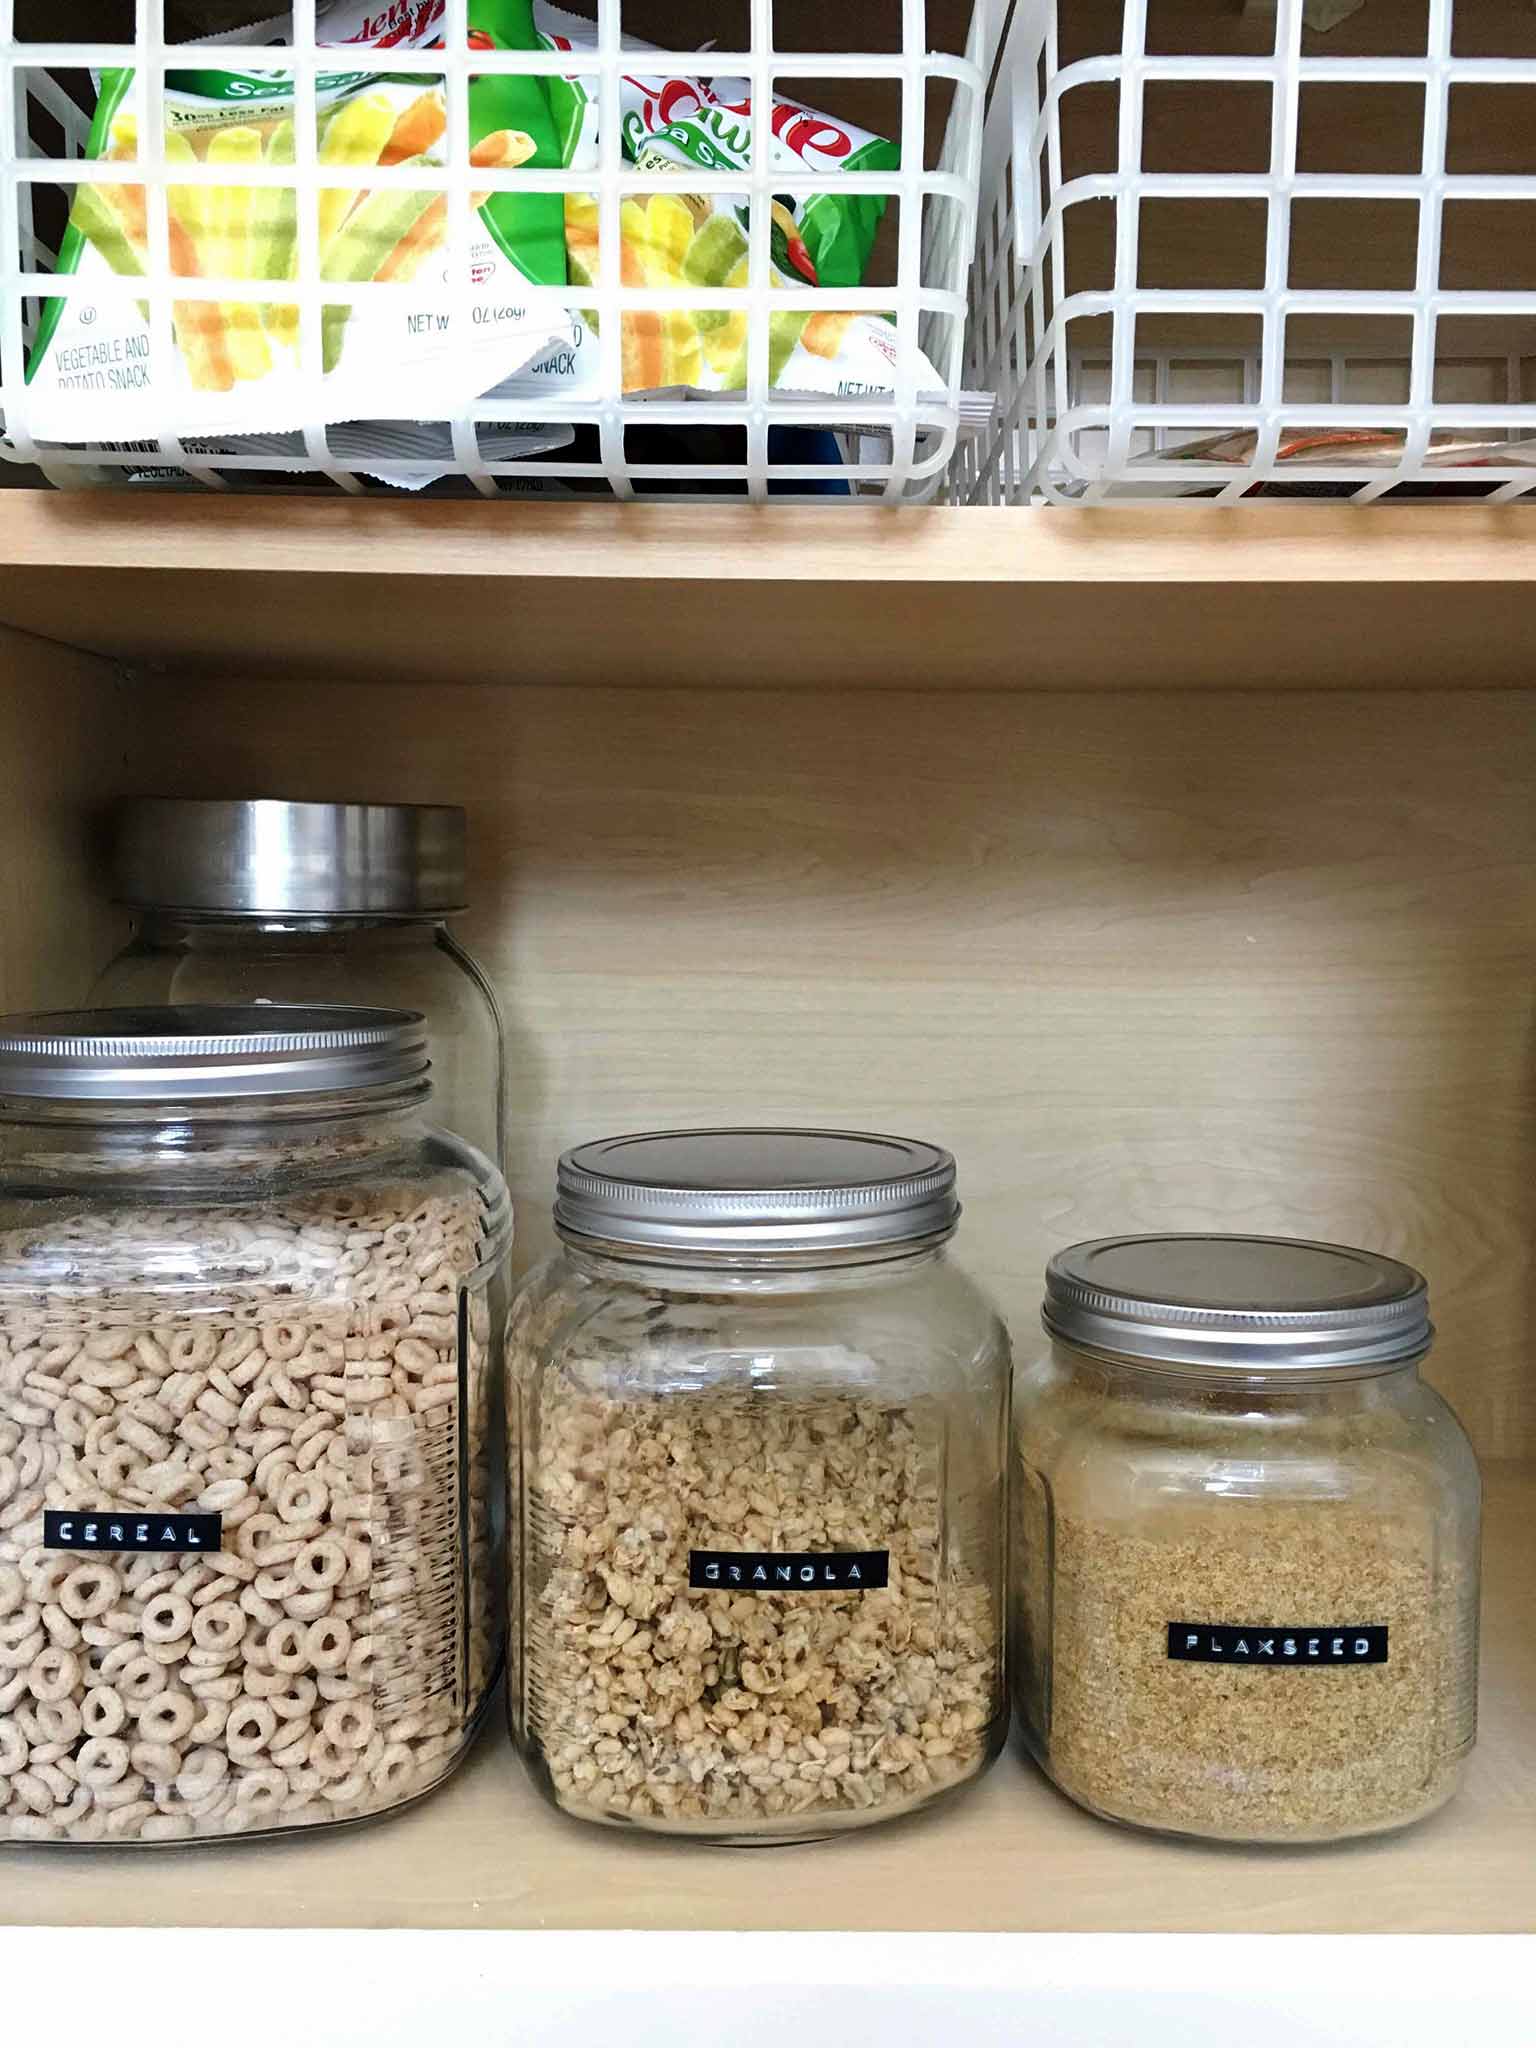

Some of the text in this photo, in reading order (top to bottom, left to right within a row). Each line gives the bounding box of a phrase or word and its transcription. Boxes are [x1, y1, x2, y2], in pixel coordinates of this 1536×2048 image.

[407, 312, 433, 335] NET
[436, 313, 450, 331] W
[56, 333, 151, 373] VEGETABLE AND
[59, 1521, 201, 1544] CEREAL
[704, 1562, 862, 1582] GRANOLA
[1186, 1633, 1370, 1656] FLAXSEED
